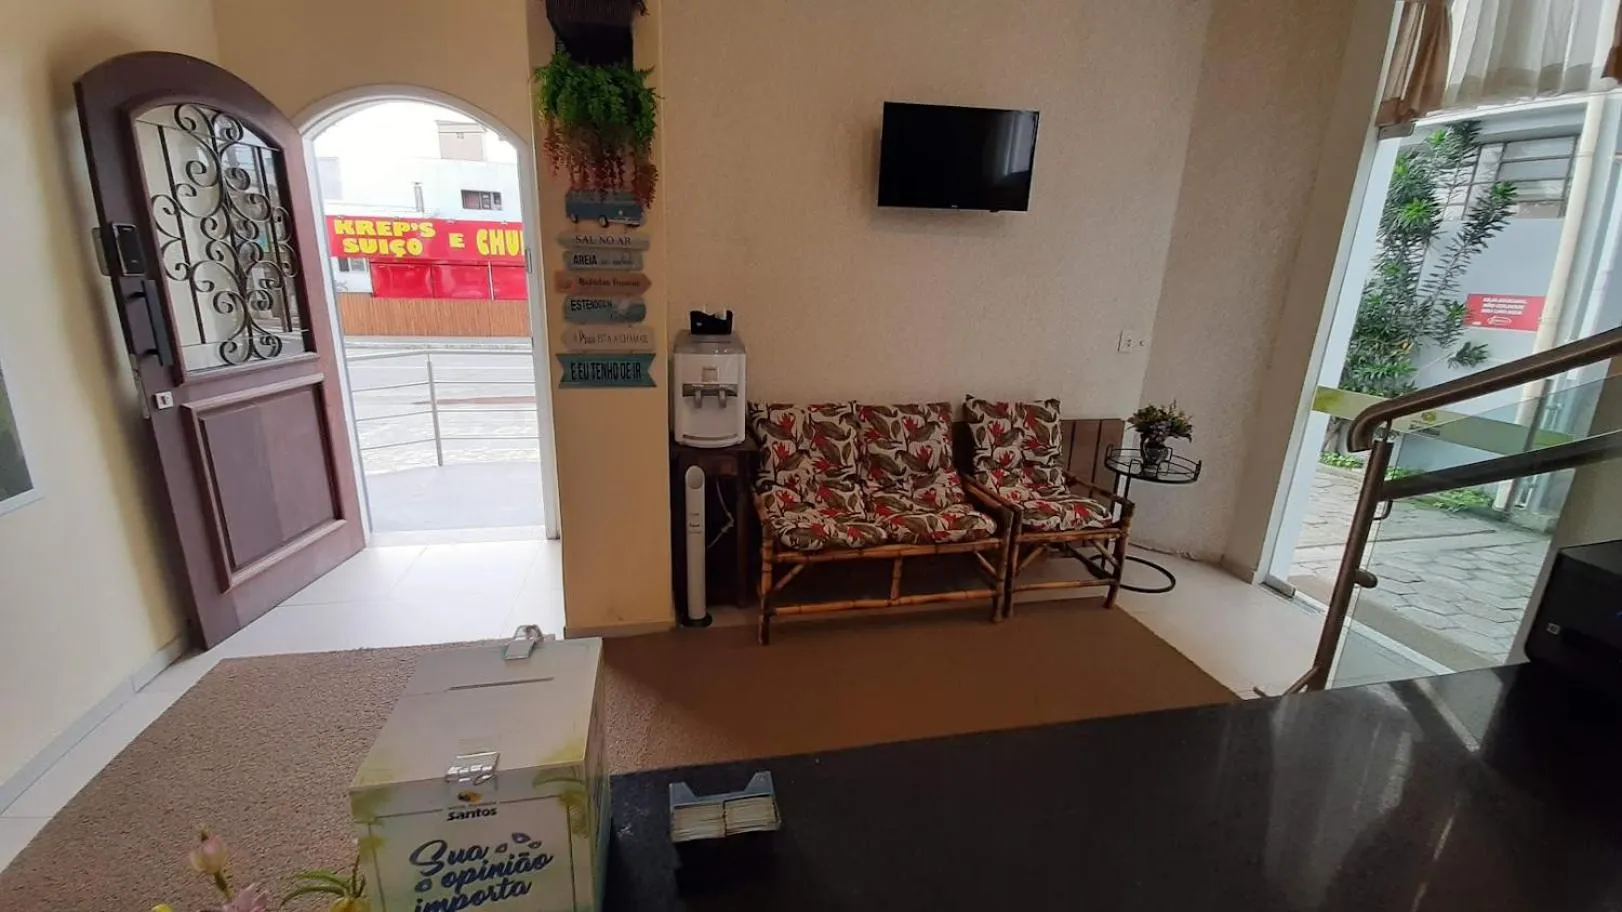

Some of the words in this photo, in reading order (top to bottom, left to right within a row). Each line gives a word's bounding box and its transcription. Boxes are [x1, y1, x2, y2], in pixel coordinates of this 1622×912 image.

[333, 219, 436, 238] KREP'S
[342, 237, 424, 258] SUIÇO
[449, 232, 465, 249] E
[476, 228, 525, 256] CHU
[575, 234, 594, 245] SAL
[599, 235, 615, 246] NO
[616, 235, 631, 246] AR
[573, 253, 598, 265] AREIA
[570, 361, 577, 380] E
[578, 361, 589, 380] EU
[590, 361, 619, 380] TENHO
[620, 361, 631, 379] DE
[409, 839, 491, 877] Sua
[441, 851, 554, 894] opinião
[414, 876, 533, 912] importa
